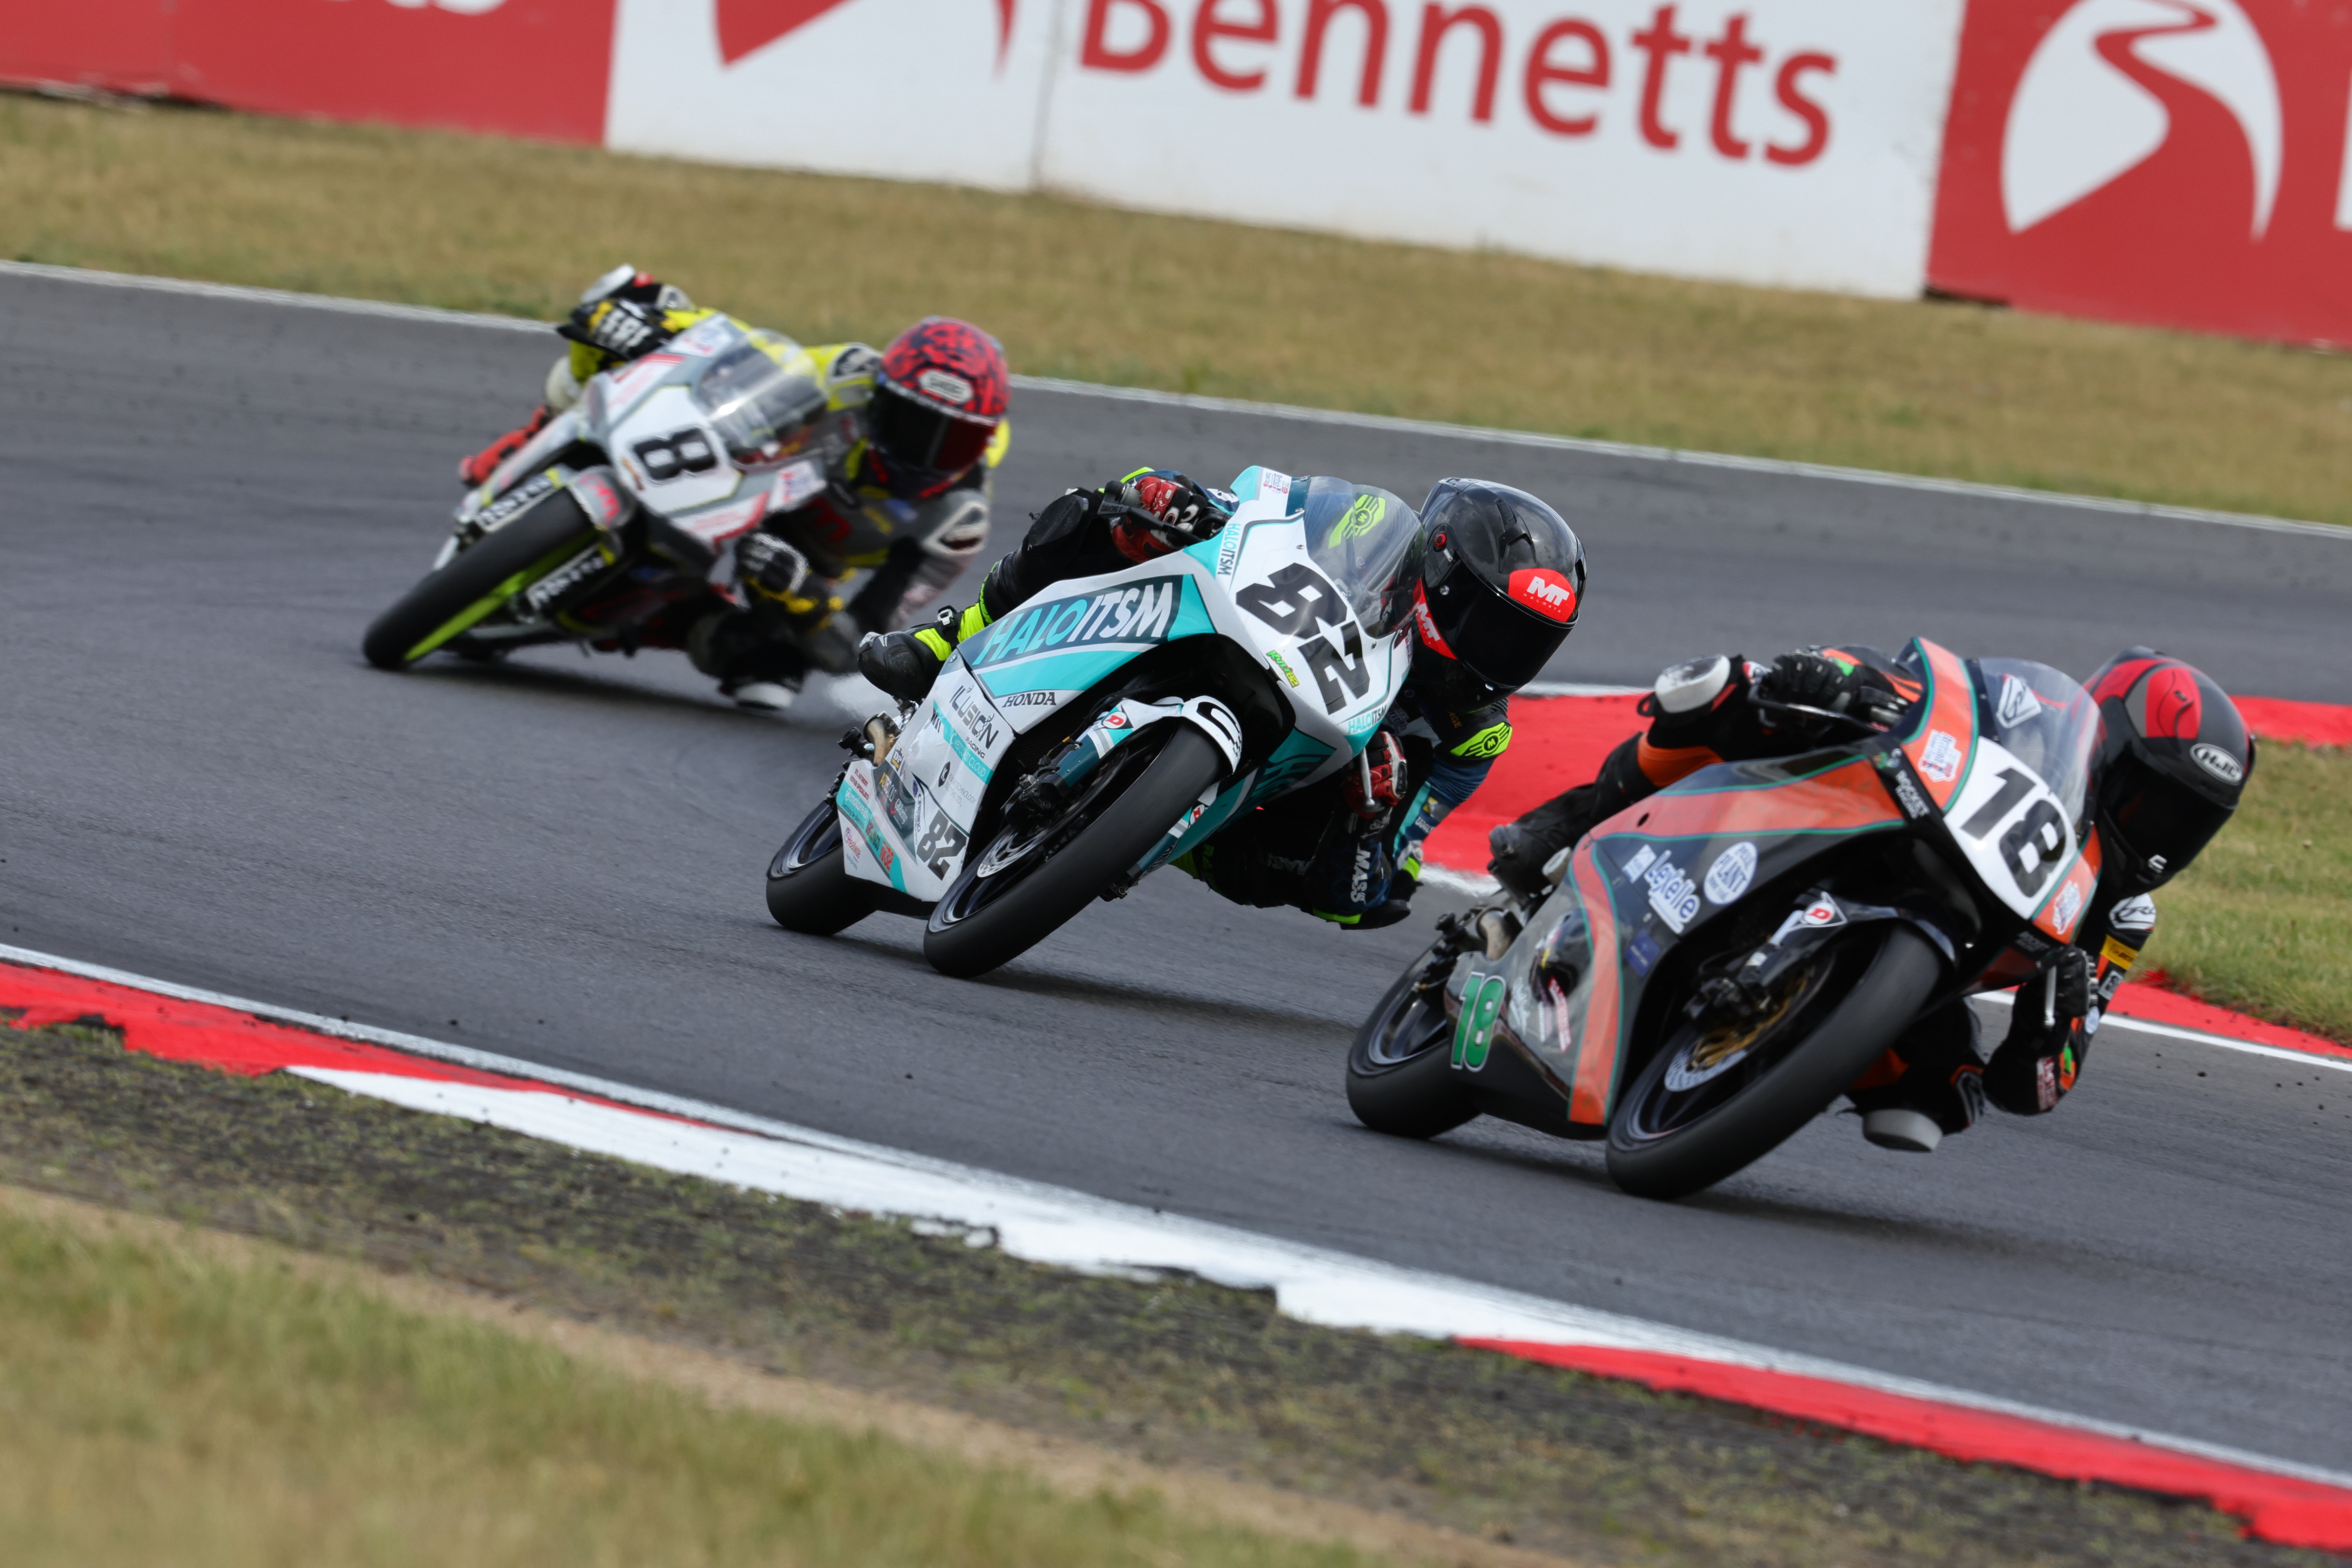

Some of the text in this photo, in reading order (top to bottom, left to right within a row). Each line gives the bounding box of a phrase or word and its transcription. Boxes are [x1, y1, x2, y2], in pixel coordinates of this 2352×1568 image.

[1079, 0, 1838, 168] Bennetts
[633, 427, 718, 481] 8
[1523, 593, 1562, 613] HELMETS
[1526, 576, 1570, 606] MT
[1235, 562, 1370, 715] 82
[1002, 691, 1057, 708] HONDA
[965, 736, 985, 760] RACING
[968, 757, 987, 778] CLOUD
[916, 809, 967, 881] 82
[1960, 767, 2068, 898] 18
[1451, 971, 1506, 1073] 18
